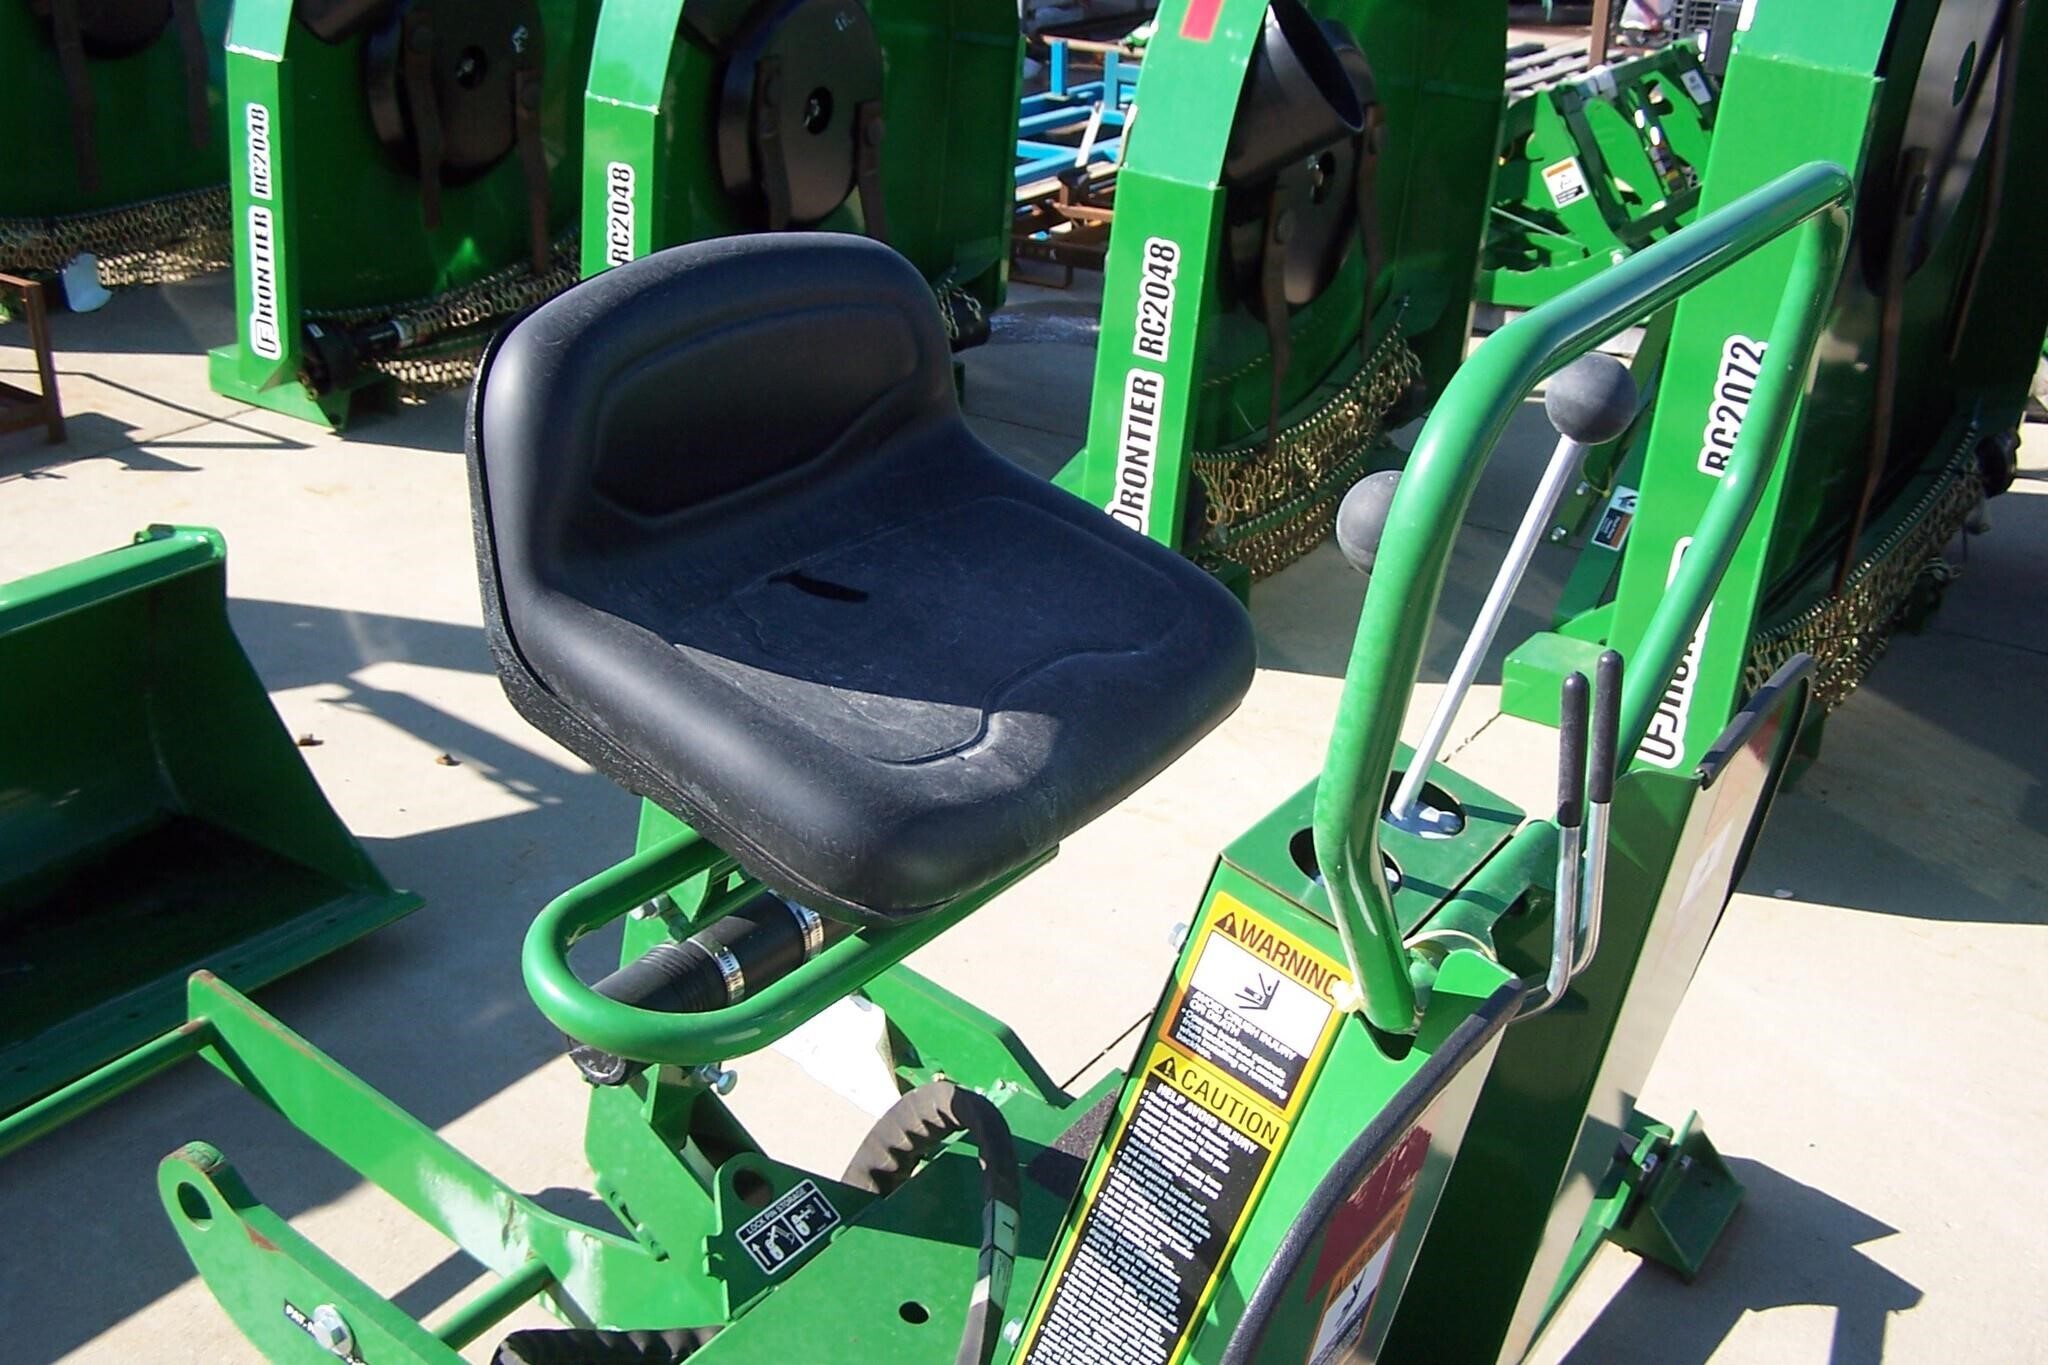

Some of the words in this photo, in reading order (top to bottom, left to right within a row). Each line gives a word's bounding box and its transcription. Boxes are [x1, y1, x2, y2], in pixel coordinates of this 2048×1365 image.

[251, 107, 268, 196] RC2048
[611, 167, 630, 264] RC2048
[254, 212, 277, 354] FRONTIER
[1139, 243, 1175, 355] RC2048
[1705, 341, 1765, 471] RC2072
[1156, 1082, 1185, 1108] HELP
[1184, 1100, 1218, 1130] AVOID
[1216, 1123, 1257, 1156] INJURY
[1180, 1069, 1280, 1144] CAUTION
[746, 1219, 767, 1235] LOCK
[765, 1209, 778, 1221] PIN
[776, 1187, 806, 1210] STORAGE
